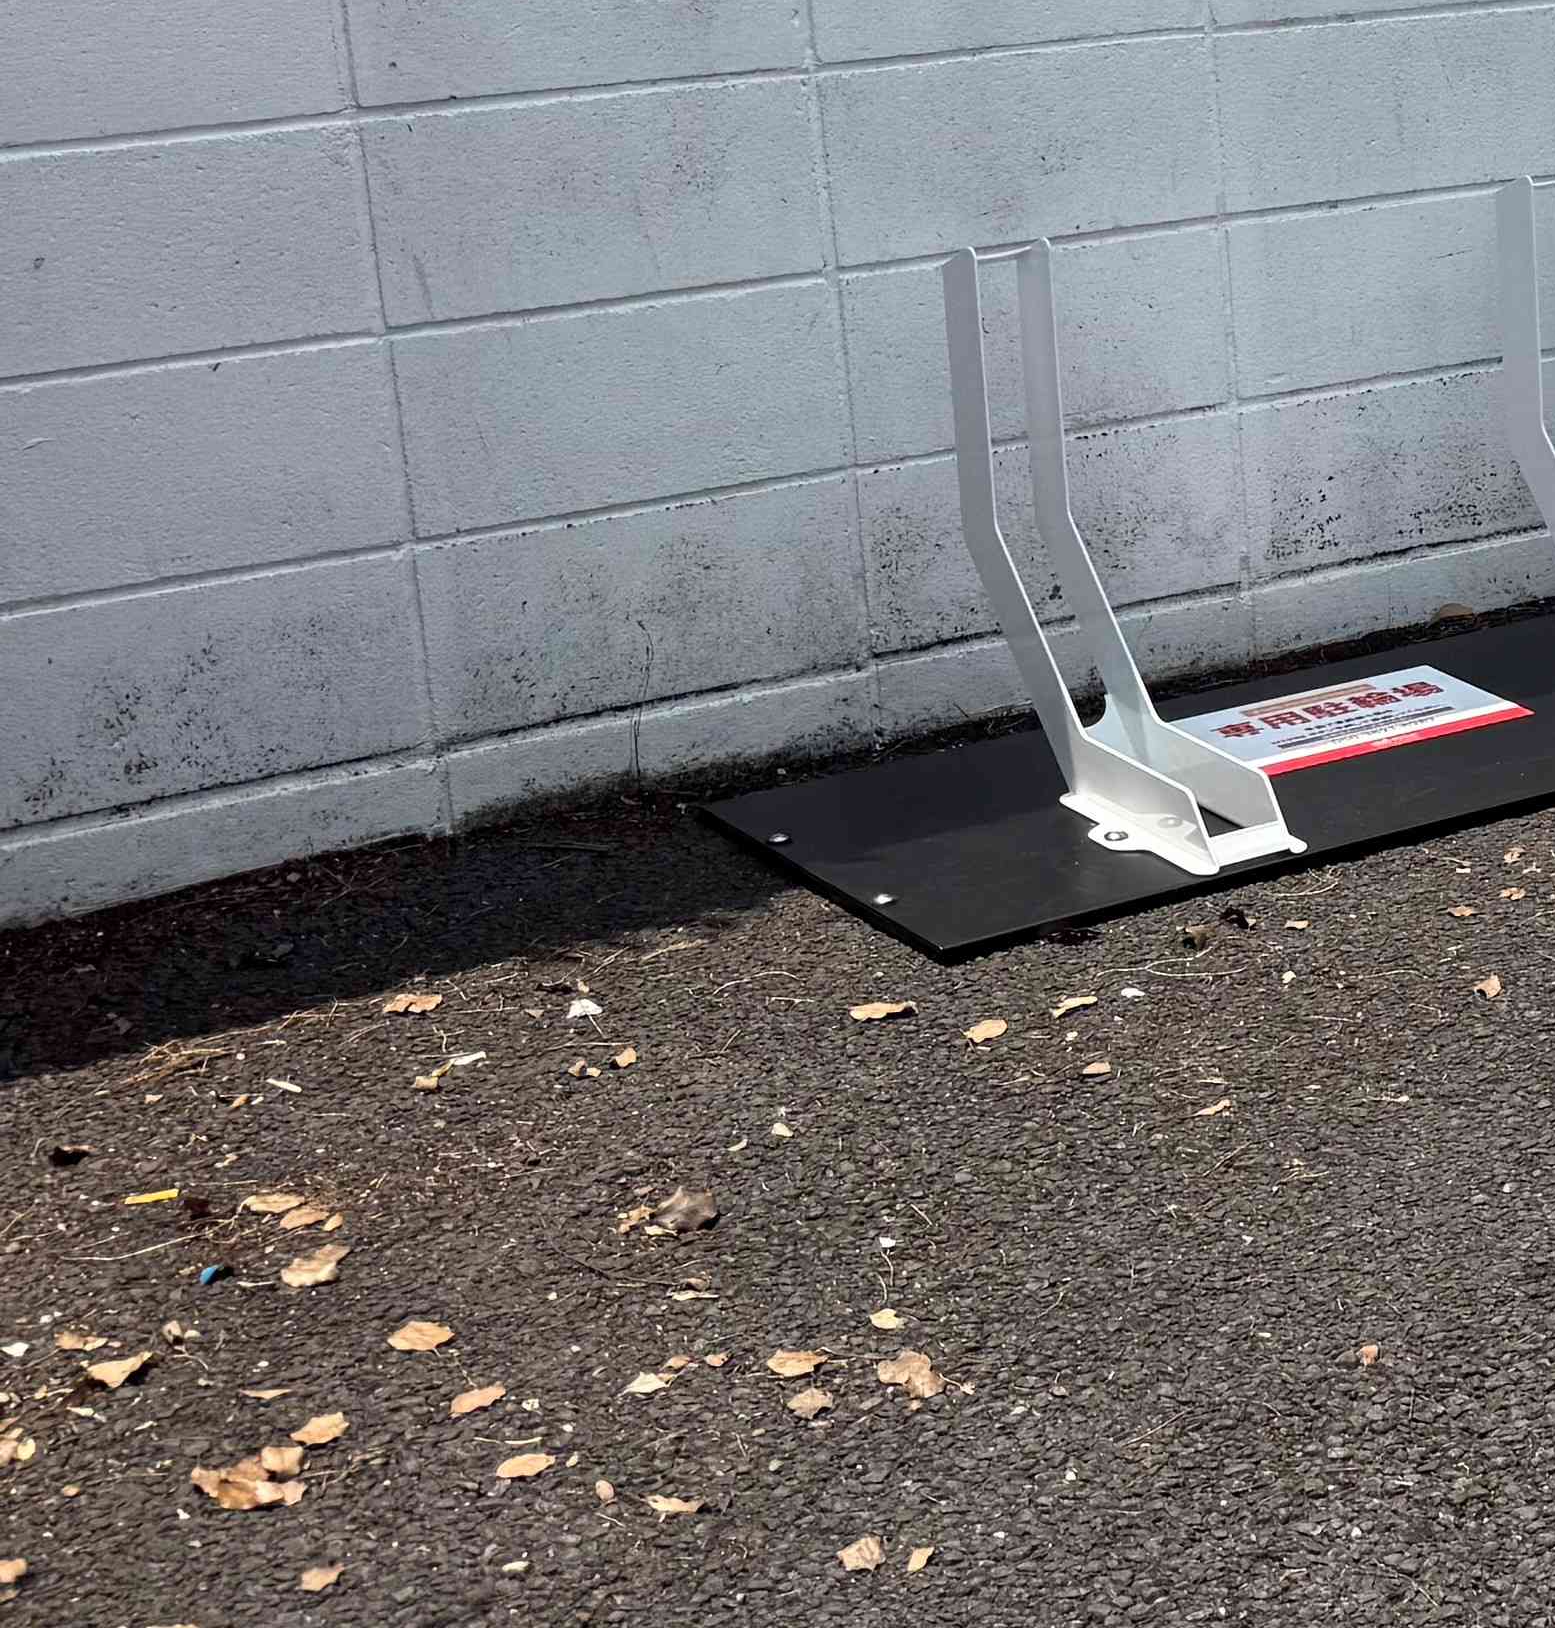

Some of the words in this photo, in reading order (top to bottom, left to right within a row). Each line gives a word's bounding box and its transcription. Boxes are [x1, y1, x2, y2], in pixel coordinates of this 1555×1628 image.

[1210, 681, 1444, 738] 専用駐輪場
